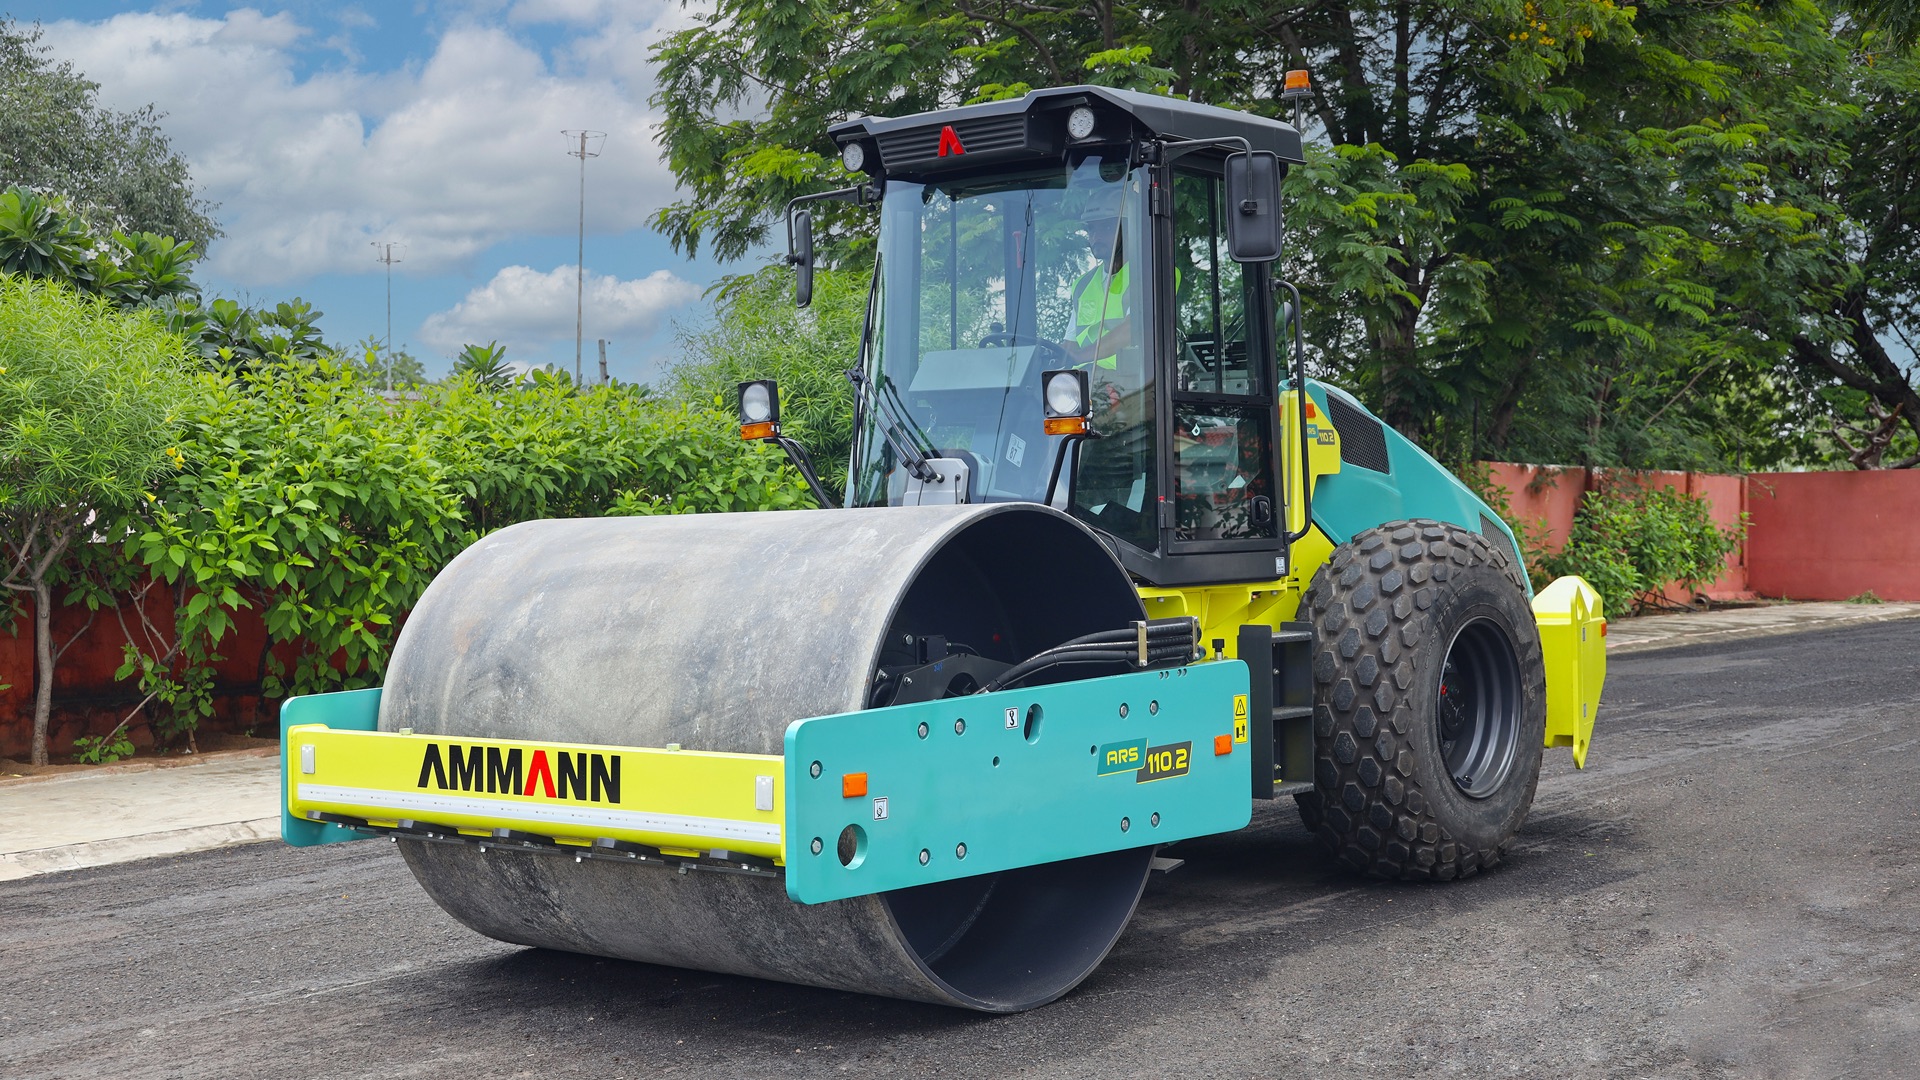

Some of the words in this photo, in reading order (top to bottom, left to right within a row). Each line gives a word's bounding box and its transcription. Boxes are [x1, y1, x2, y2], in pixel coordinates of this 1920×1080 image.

[417, 743, 621, 804] AMMANN
[1106, 746, 1139, 766] ARS
[1147, 748, 1188, 774] 110.2
